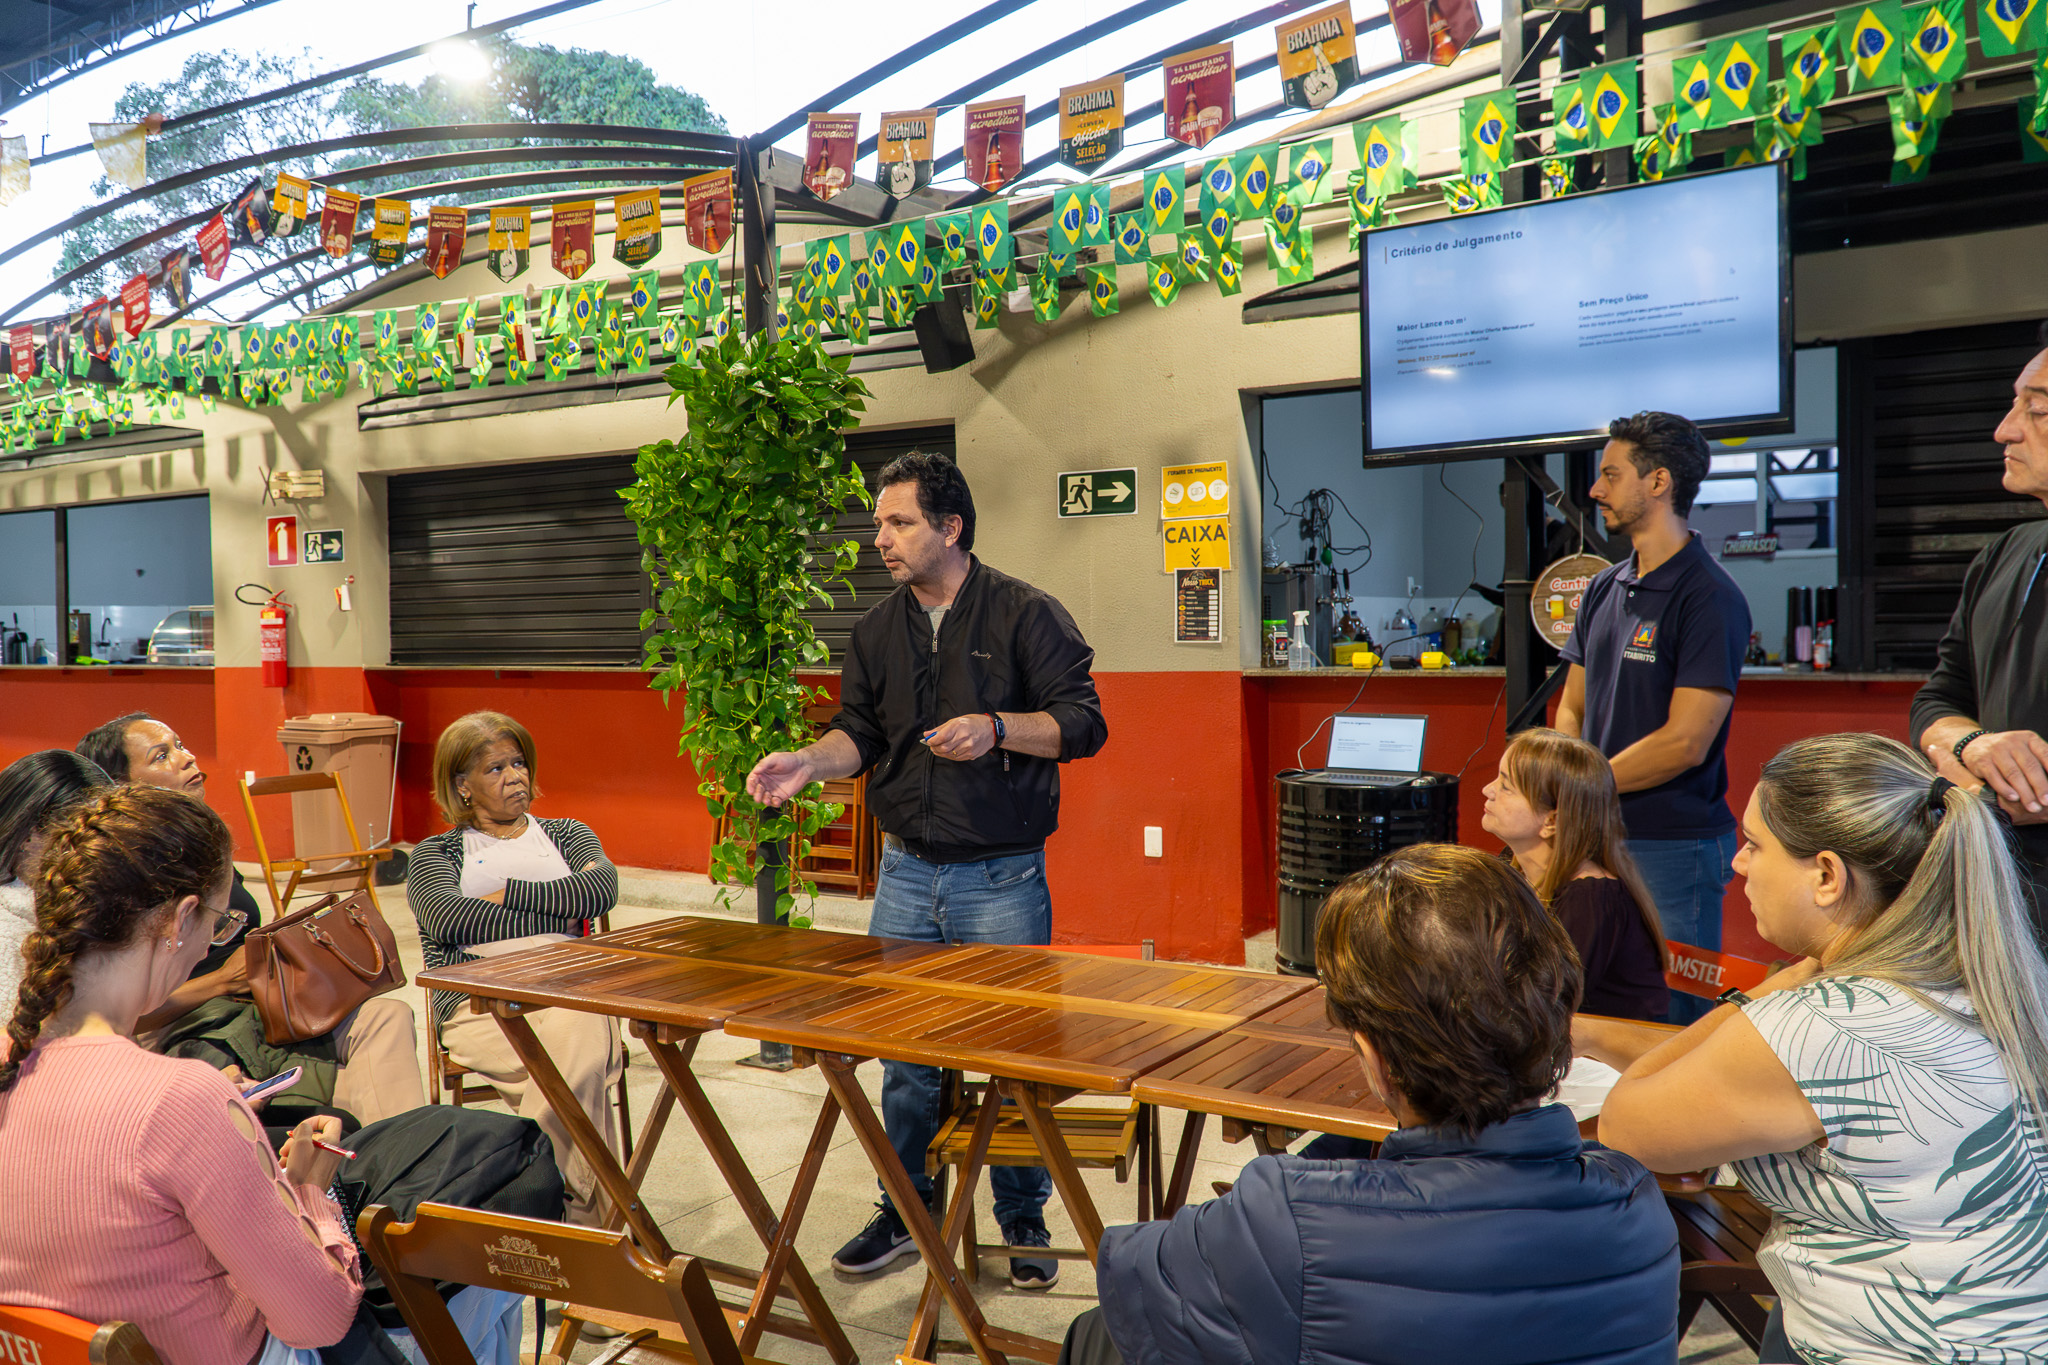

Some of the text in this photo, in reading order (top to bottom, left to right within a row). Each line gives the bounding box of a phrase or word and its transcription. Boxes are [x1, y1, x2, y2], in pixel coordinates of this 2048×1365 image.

[1287, 17, 1342, 53] BRAHMA
[1184, 56, 1225, 71] LIBERADO
[1171, 63, 1229, 85] acreditar
[1068, 89, 1114, 115] BRAHMA
[983, 108, 1018, 118] LIBERADO
[887, 120, 926, 139] BRAHMA
[970, 115, 1020, 130] acreditar
[1071, 121, 1111, 147] Oficial
[1076, 142, 1106, 159] SELEÇÃO
[621, 199, 654, 220] BRAHMA
[495, 216, 524, 232] BRAHMA
[1391, 231, 1523, 258] Critério de Julgamento
[1579, 292, 1648, 308] Sem Preço Único
[1397, 322, 1418, 332] Maior
[1420, 320, 1442, 329] Lance
[1164, 524, 1227, 544] CAIXA
[1724, 537, 1778, 554] CHURRASCO
[1552, 621, 1575, 633] Chu
[1623, 650, 1656, 663] ITABIRITO
[0, 1329, 42, 1365] TEL
